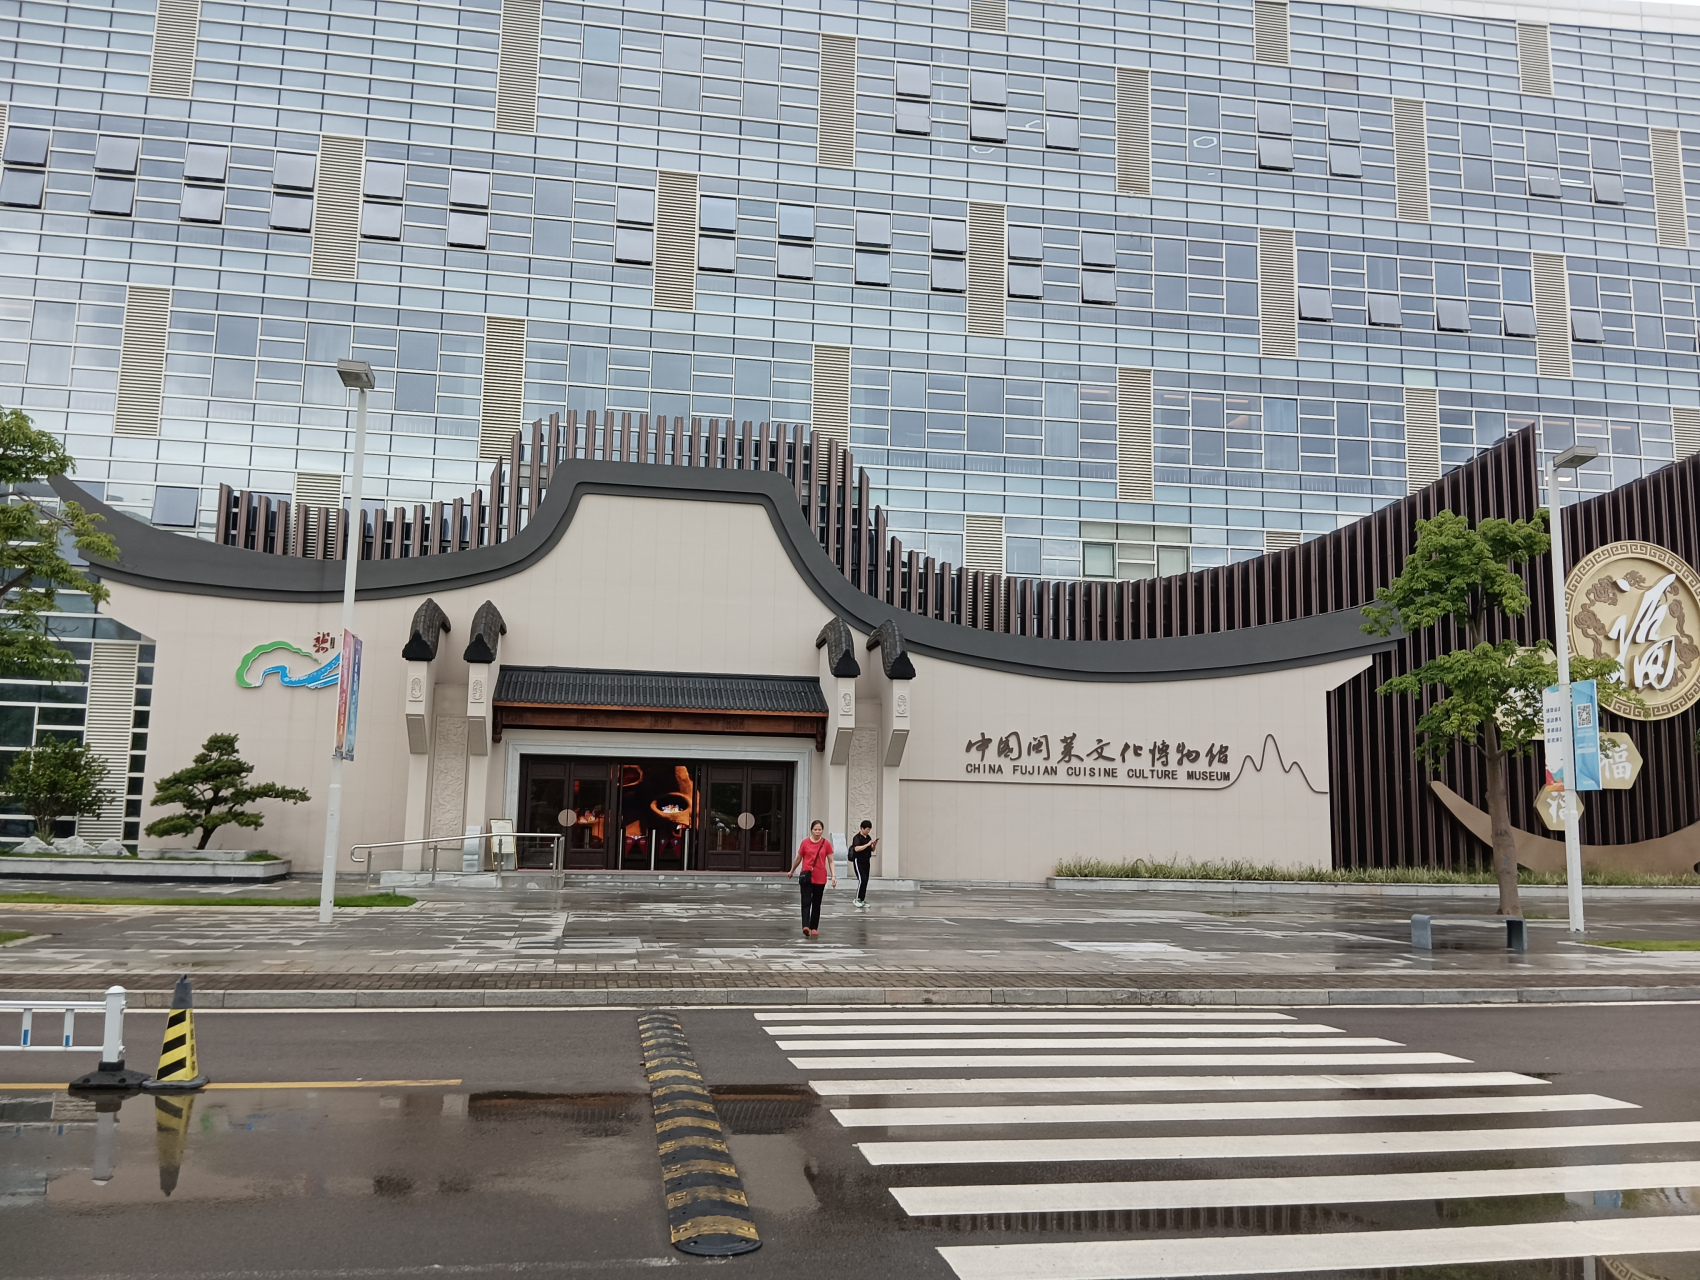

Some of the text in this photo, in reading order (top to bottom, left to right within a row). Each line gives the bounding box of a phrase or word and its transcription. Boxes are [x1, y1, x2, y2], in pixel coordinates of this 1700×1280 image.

[1607, 573, 1676, 690] 福
[965, 731, 1229, 767] 中国闽菜文化博物馆
[965, 763, 1230, 781] CHINA FUJIAN CUISINE CULTURE MUSEUM
